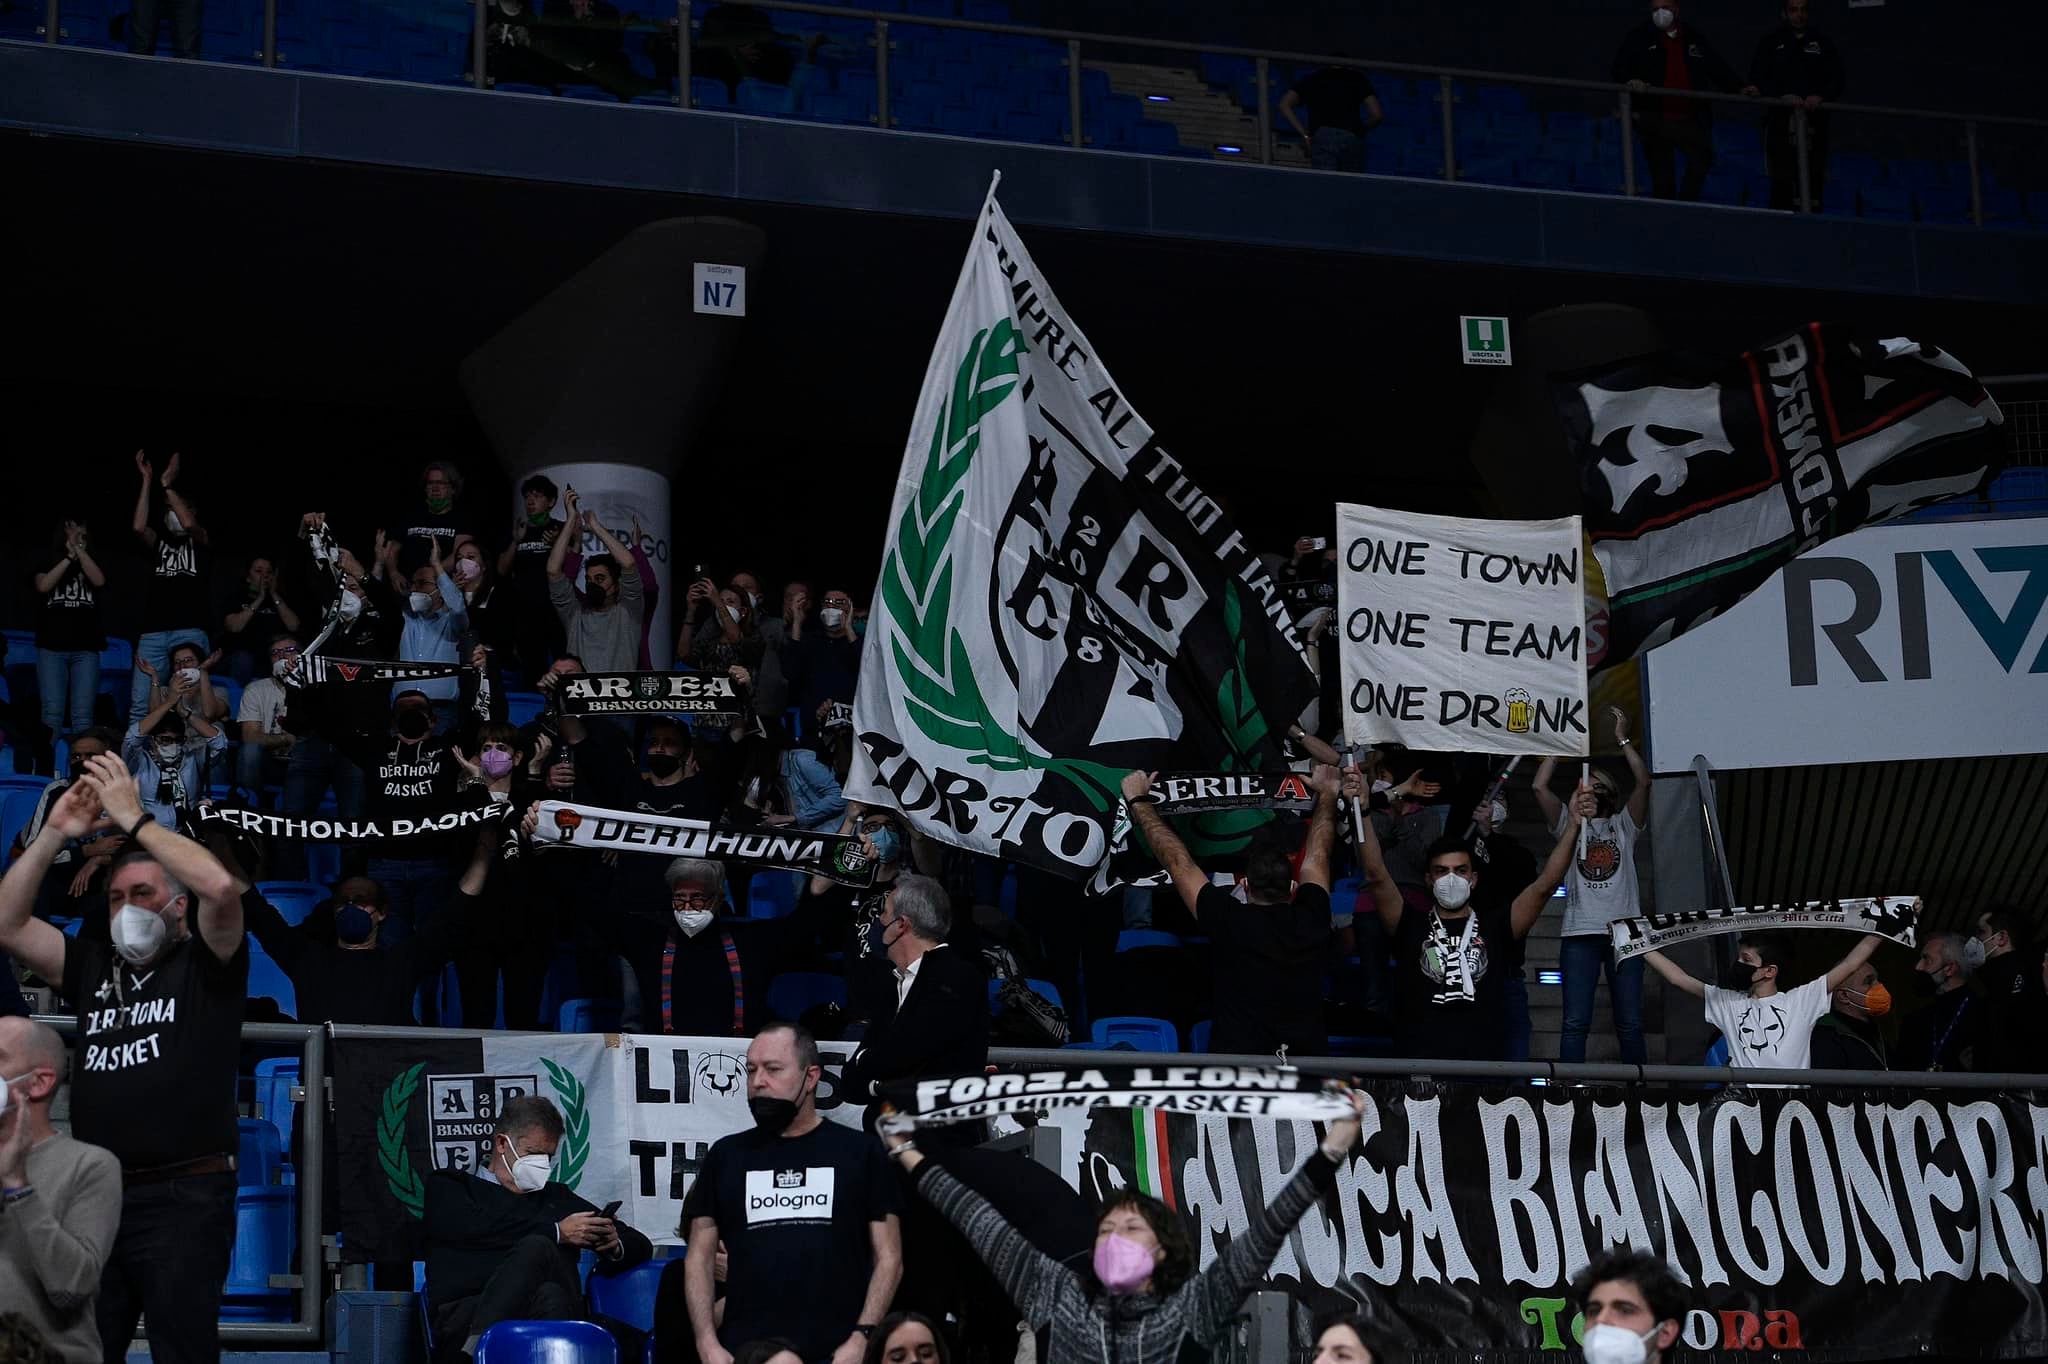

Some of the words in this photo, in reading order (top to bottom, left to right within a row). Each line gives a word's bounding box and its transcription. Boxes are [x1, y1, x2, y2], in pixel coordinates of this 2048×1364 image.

[703, 281, 737, 308] N7
[1088, 387, 1135, 450] AL
[1144, 445, 1225, 537] TUO
[1346, 537, 1430, 575] ONE
[1448, 547, 1577, 585] TOWN
[1346, 607, 1430, 648] ONE
[1449, 617, 1581, 661] TEAM
[1782, 544, 2048, 687] RIV
[1350, 678, 1428, 721] ONE
[379, 760, 441, 779] DERTHONA
[383, 779, 435, 798] BASKET
[1148, 775, 1266, 805] SERIE
[1273, 774, 1312, 801] A
[83, 1033, 161, 1072] BASKET
[915, 1070, 1110, 1114] FORZA
[1129, 1065, 1300, 1091] LEONI
[1131, 1095, 1279, 1114] BASKET
[751, 1193, 828, 1211] bologna
